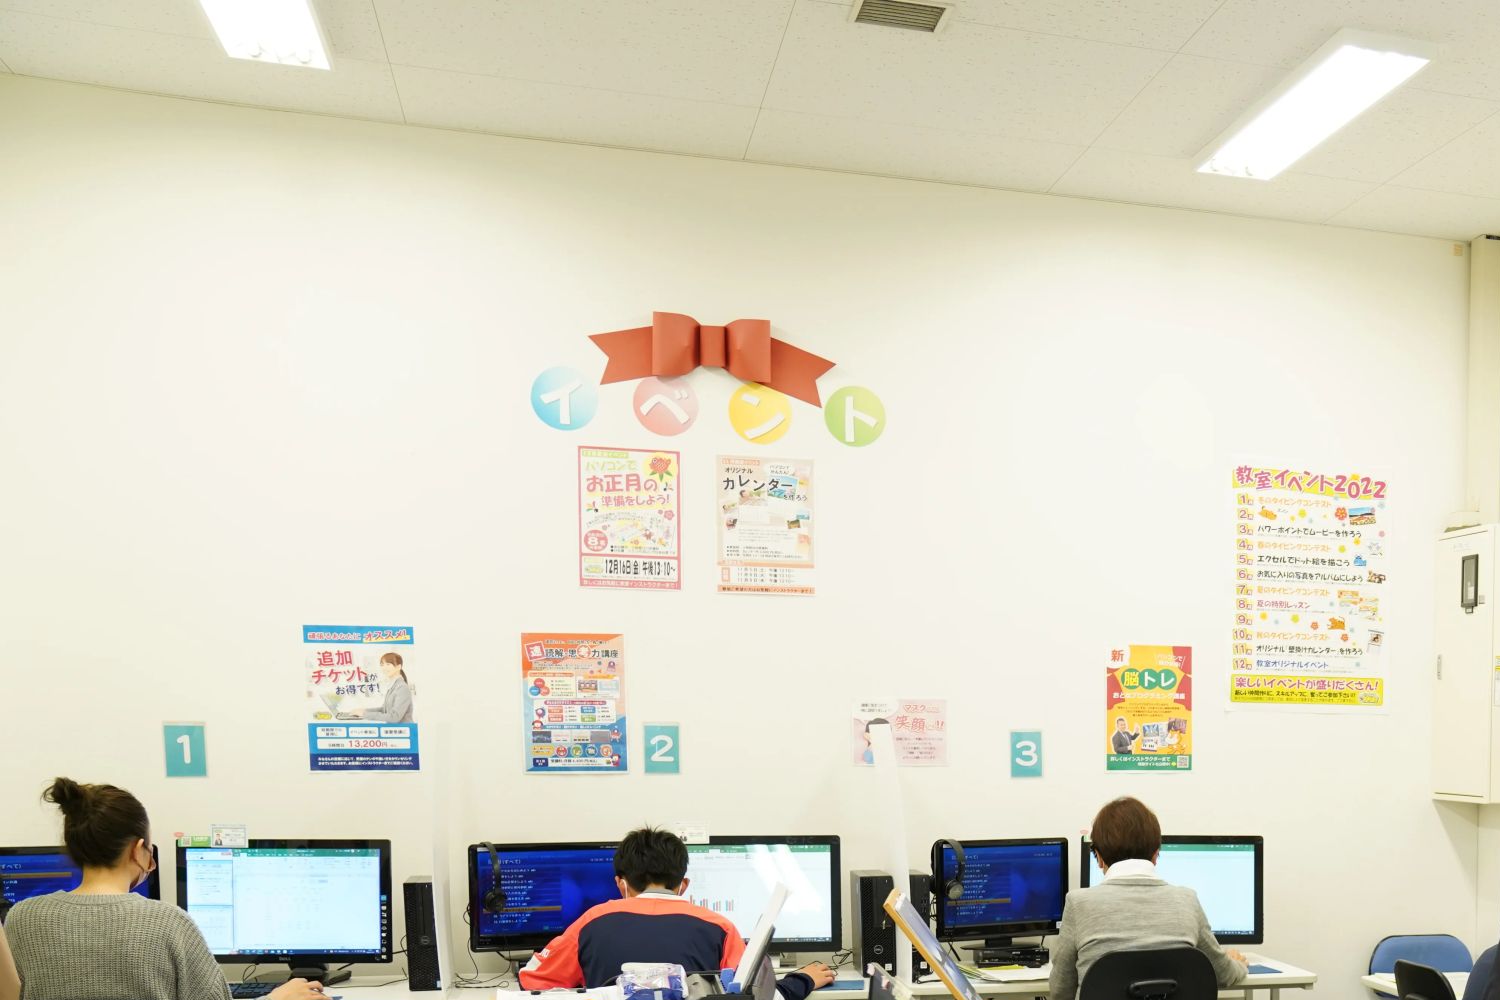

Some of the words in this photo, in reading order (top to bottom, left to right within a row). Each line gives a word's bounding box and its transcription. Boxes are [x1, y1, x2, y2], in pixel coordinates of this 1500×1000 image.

[540, 380, 879, 443] イベント
[586, 473, 659, 493] お正月の
[722, 475, 793, 492] カレンダー
[1236, 465, 1387, 499] 教室イベント2022
[316, 650, 353, 667] 追加
[1111, 649, 1125, 662] 新
[335, 683, 380, 695] お得です!
[1123, 671, 1175, 687] 脳トレ
[176, 734, 191, 764] 1
[650, 734, 674, 762] 2
[1015, 740, 1038, 767] 3
